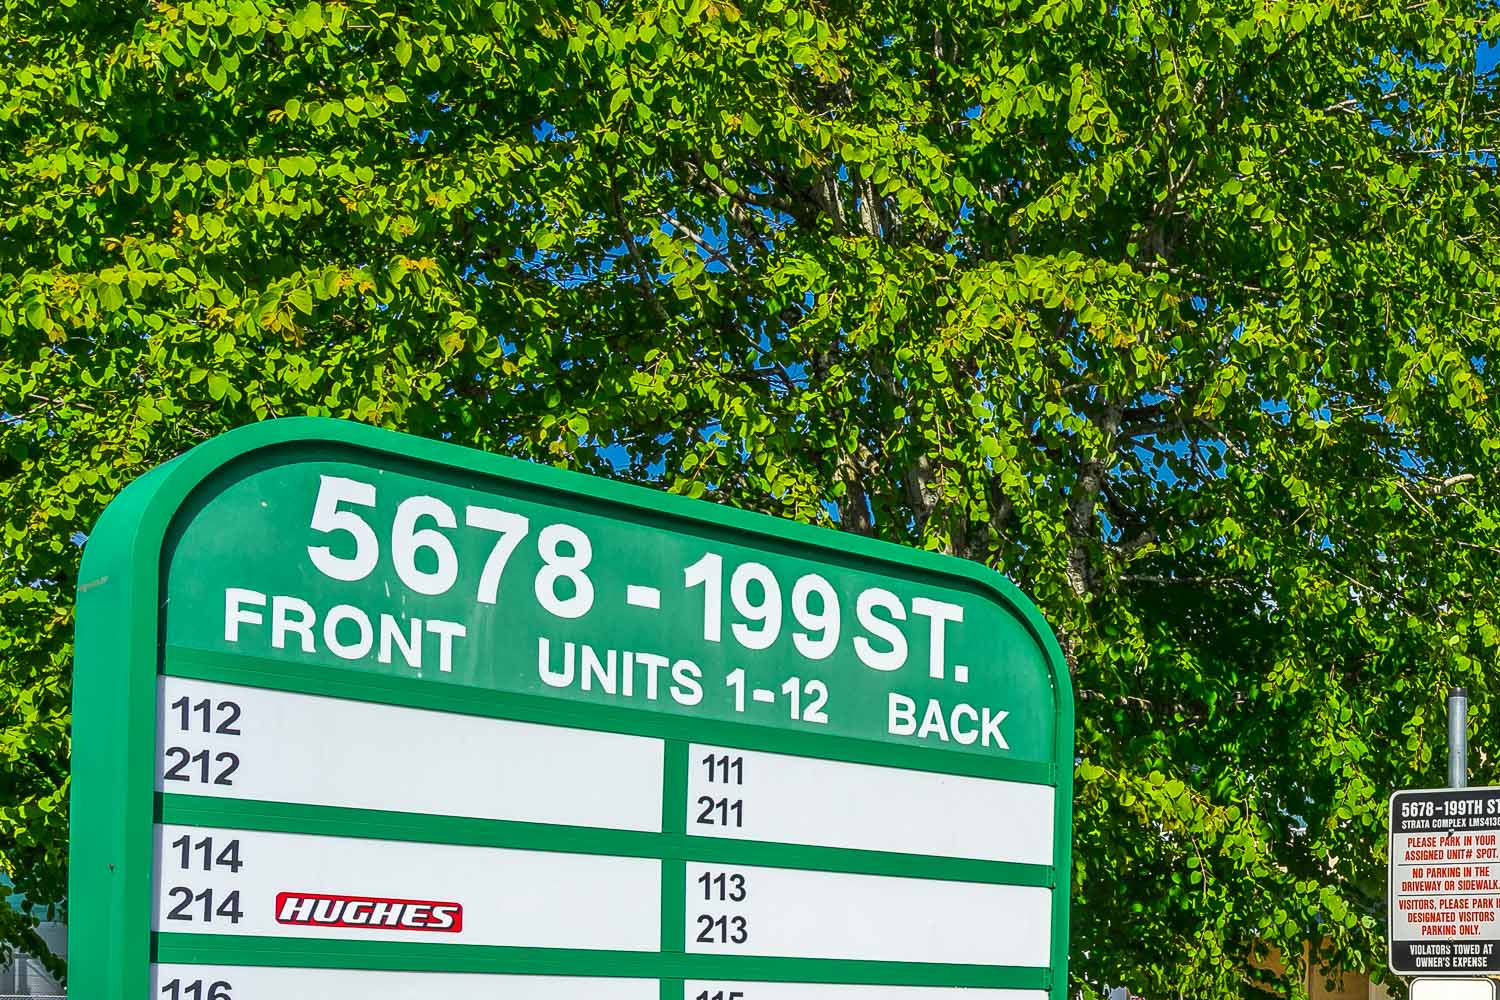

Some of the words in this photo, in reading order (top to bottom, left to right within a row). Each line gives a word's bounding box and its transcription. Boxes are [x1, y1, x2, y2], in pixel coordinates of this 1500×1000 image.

[307, 475, 595, 619] 5678
[224, 588, 466, 672] FRONT
[539, 638, 703, 705] UNITS
[726, 669, 827, 723] 1-12
[172, 696, 240, 735] 112
[889, 693, 1008, 749] BACK
[162, 744, 239, 789] 212
[703, 754, 743, 785] 111
[697, 796, 742, 827] 211
[1402, 820, 1430, 829] STRATA
[1432, 819, 1466, 828] COMPLEX
[173, 835, 243, 873] 114
[1405, 850, 1443, 861] ASSIGNED
[1447, 849, 1472, 859] UNIT#
[1476, 848, 1498, 858] SPOT.
[1408, 837, 1436, 847] PLEASE
[1440, 836, 1460, 847] PARK
[1464, 836, 1471, 845] IN
[1475, 835, 1495, 845] YOUR
[699, 872, 746, 902] 113
[1402, 881, 1441, 891] DRIVEWAY
[1445, 881, 1454, 890] OR
[1413, 868, 1423, 878] NO
[1427, 867, 1460, 877] PARKING
[1464, 867, 1471, 876] IN
[1475, 867, 1490, 876] THE
[167, 887, 243, 923] 214
[279, 897, 457, 930] HUGHES
[1399, 900, 1437, 910] VISITORS,
[1440, 899, 1469, 909] PLEASE
[1472, 898, 1493, 908] PARK
[1408, 912, 1455, 922] DESIGNATED
[1459, 912, 1494, 922] VISITORS
[697, 915, 747, 944] 213
[1422, 925, 1456, 935] PARKING
[1460, 925, 1480, 935] ONLY.
[1410, 945, 1451, 955] VIOLATORS
[1454, 944, 1480, 954] TOWED
[1483, 944, 1493, 954] AT
[1416, 957, 1450, 967] OWNER'S
[1453, 957, 1487, 967] EXPENSE
